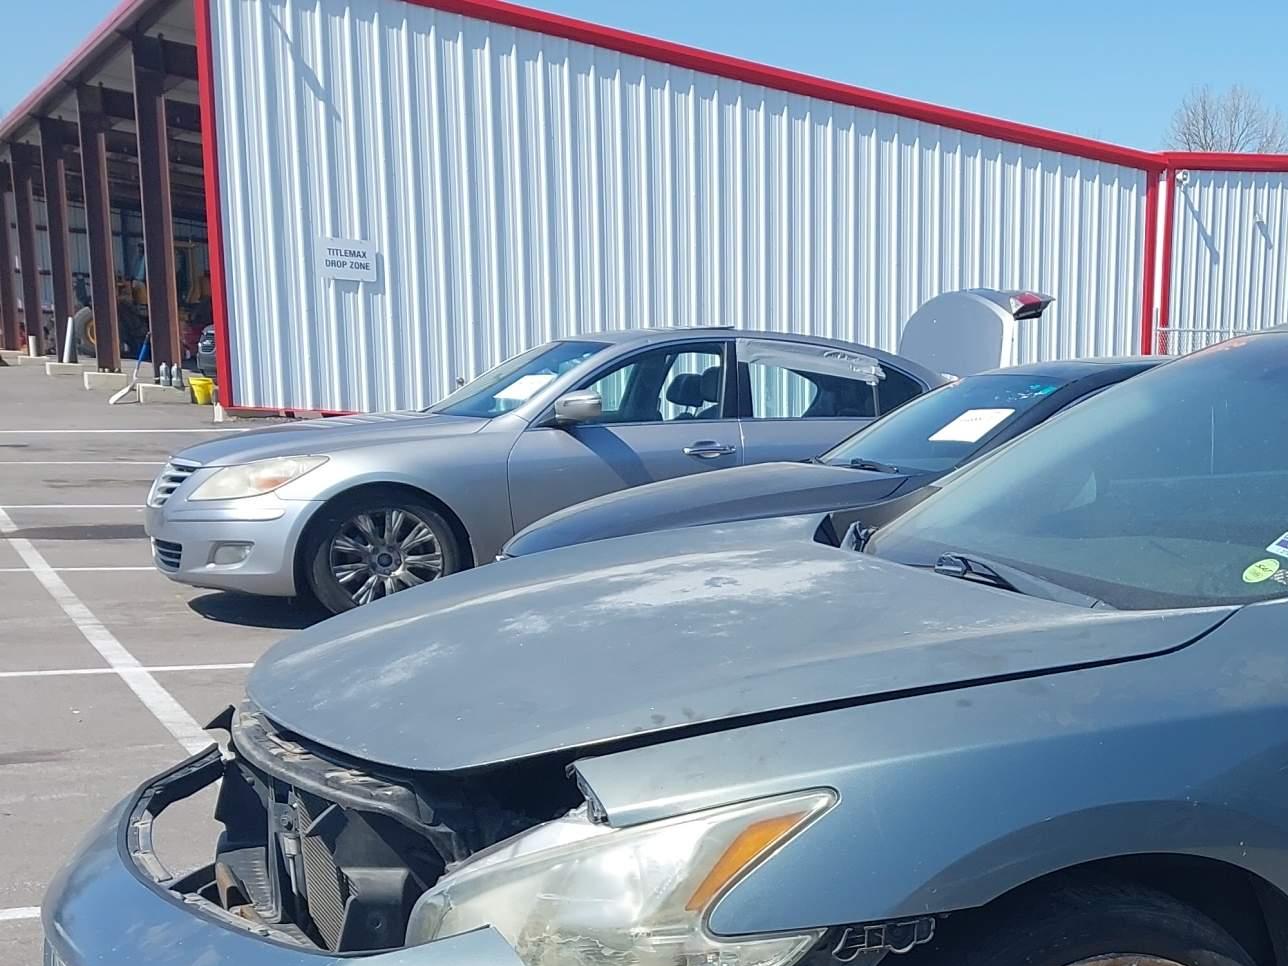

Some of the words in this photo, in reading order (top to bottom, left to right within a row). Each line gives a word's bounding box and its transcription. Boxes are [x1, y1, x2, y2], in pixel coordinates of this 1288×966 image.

[327, 247, 367, 259] TITLEMAX
[325, 259, 347, 269] DROP
[349, 261, 372, 271] ZONE
